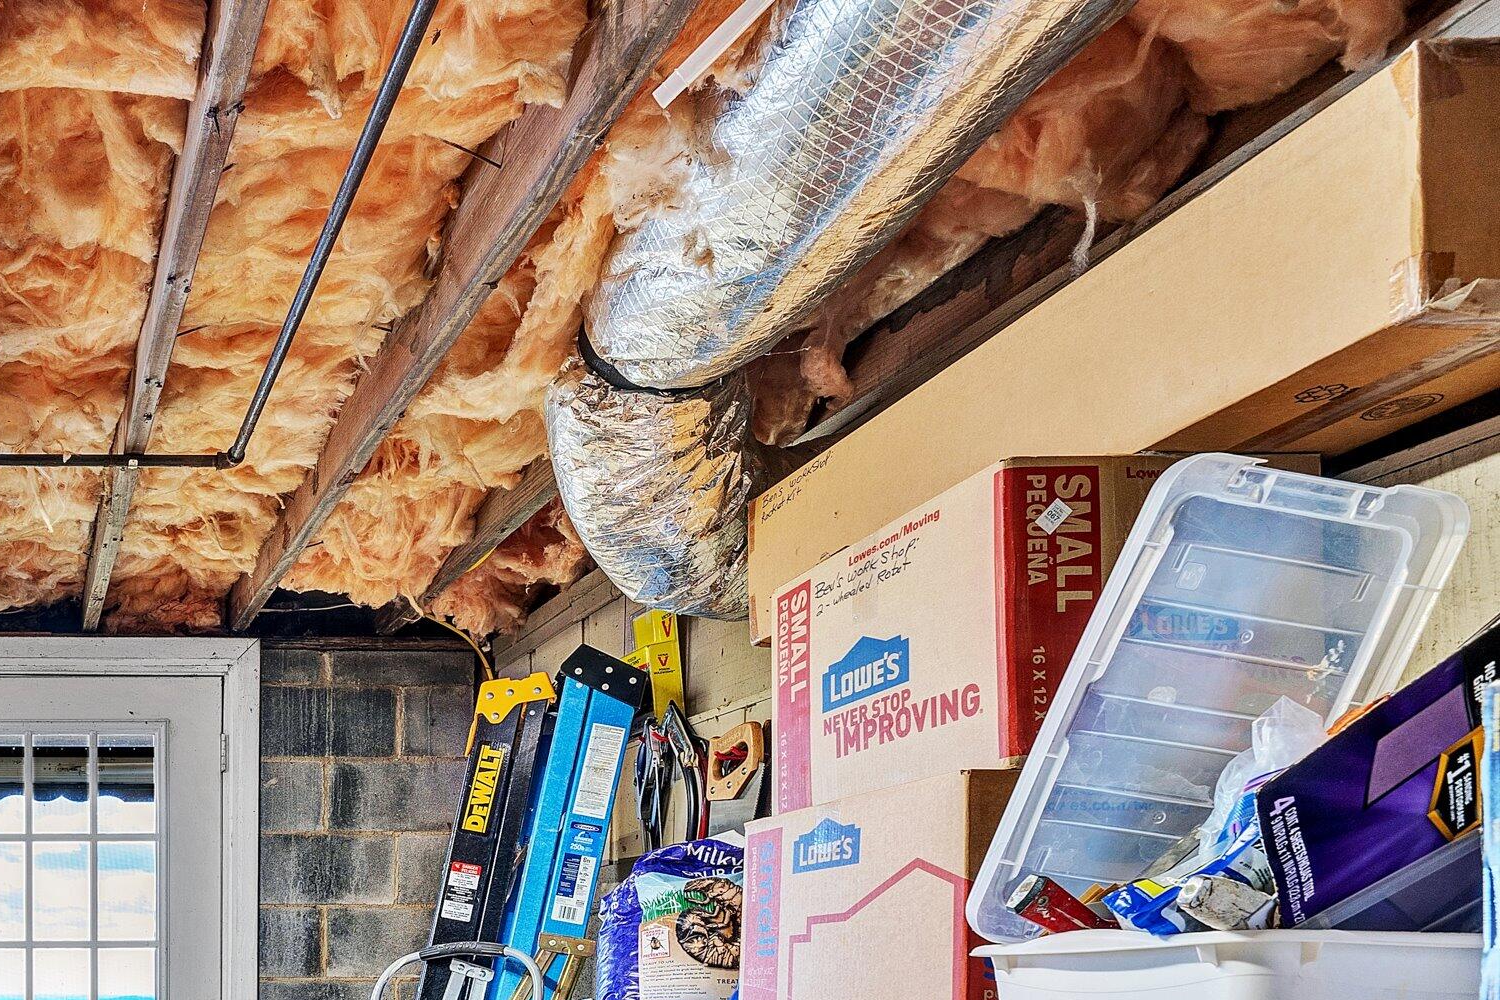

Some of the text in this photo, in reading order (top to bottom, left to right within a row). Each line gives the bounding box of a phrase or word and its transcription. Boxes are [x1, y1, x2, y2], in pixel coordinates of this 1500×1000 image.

[848, 508, 940, 567] Lowes.com/Moving
[1046, 510, 1060, 521] 067
[1054, 474, 1093, 613] SMALL
[789, 589, 808, 703] SMALL
[1032, 645, 1046, 664] 16
[830, 651, 903, 703] LOWE'S
[1033, 669, 1046, 681] X
[1034, 686, 1047, 705] 12
[823, 688, 912, 737] NEVER STOP
[781, 731, 788, 809] 16 X 12 X 12
[1446, 752, 1471, 784] #1
[799, 834, 854, 867] LOWE'S
[1269, 796, 1296, 817] 4
[1284, 806, 1301, 830] CONT.
[1301, 877, 1316, 902] TOTAL
[1278, 852, 1292, 863] 11
[756, 842, 778, 957] small
